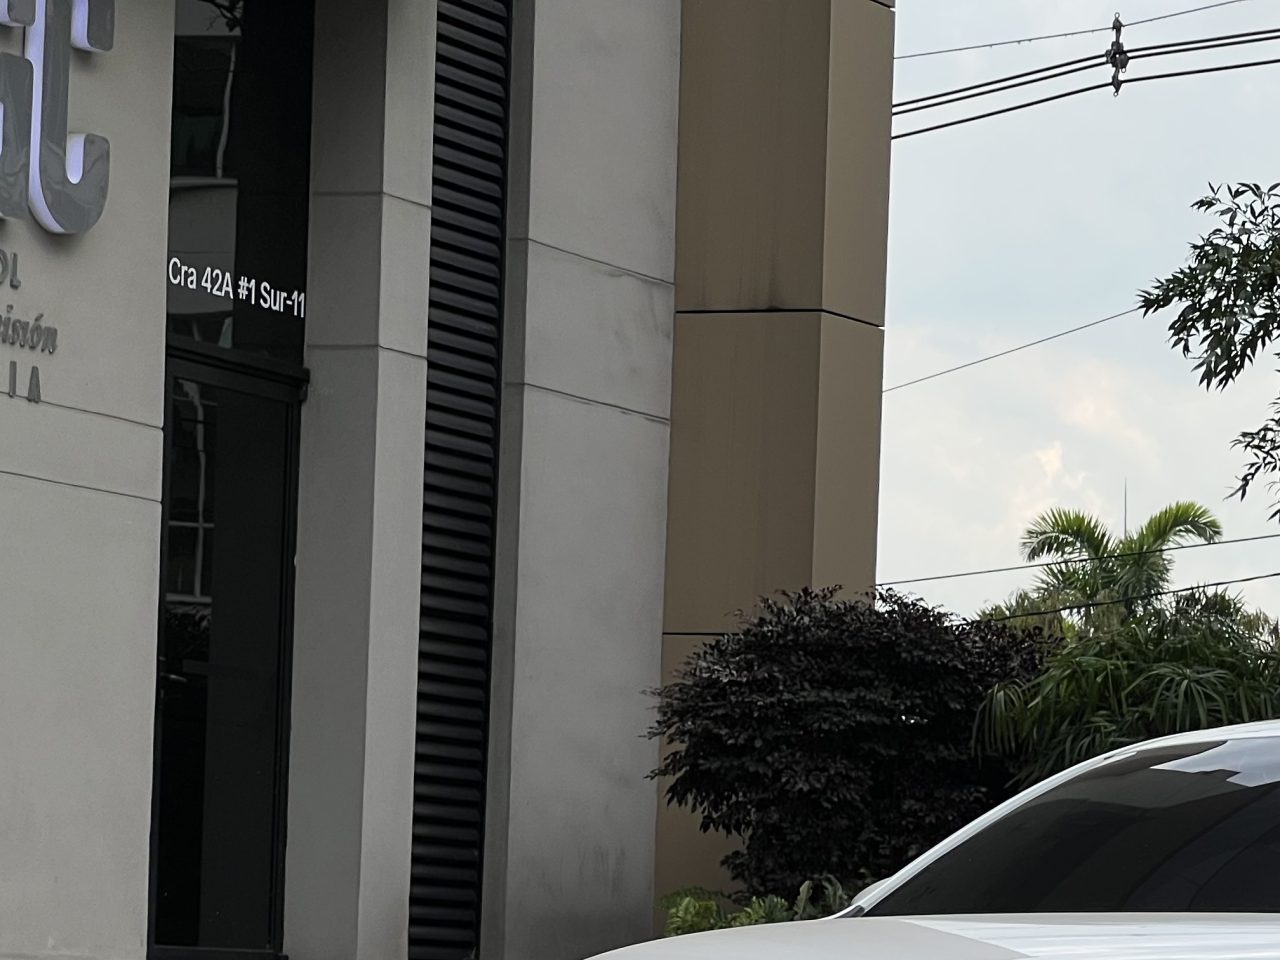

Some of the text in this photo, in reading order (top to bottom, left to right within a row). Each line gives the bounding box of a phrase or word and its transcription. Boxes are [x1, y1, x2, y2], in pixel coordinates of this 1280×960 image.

[168, 257, 305, 318] Cra 42A #1 Sur-11
